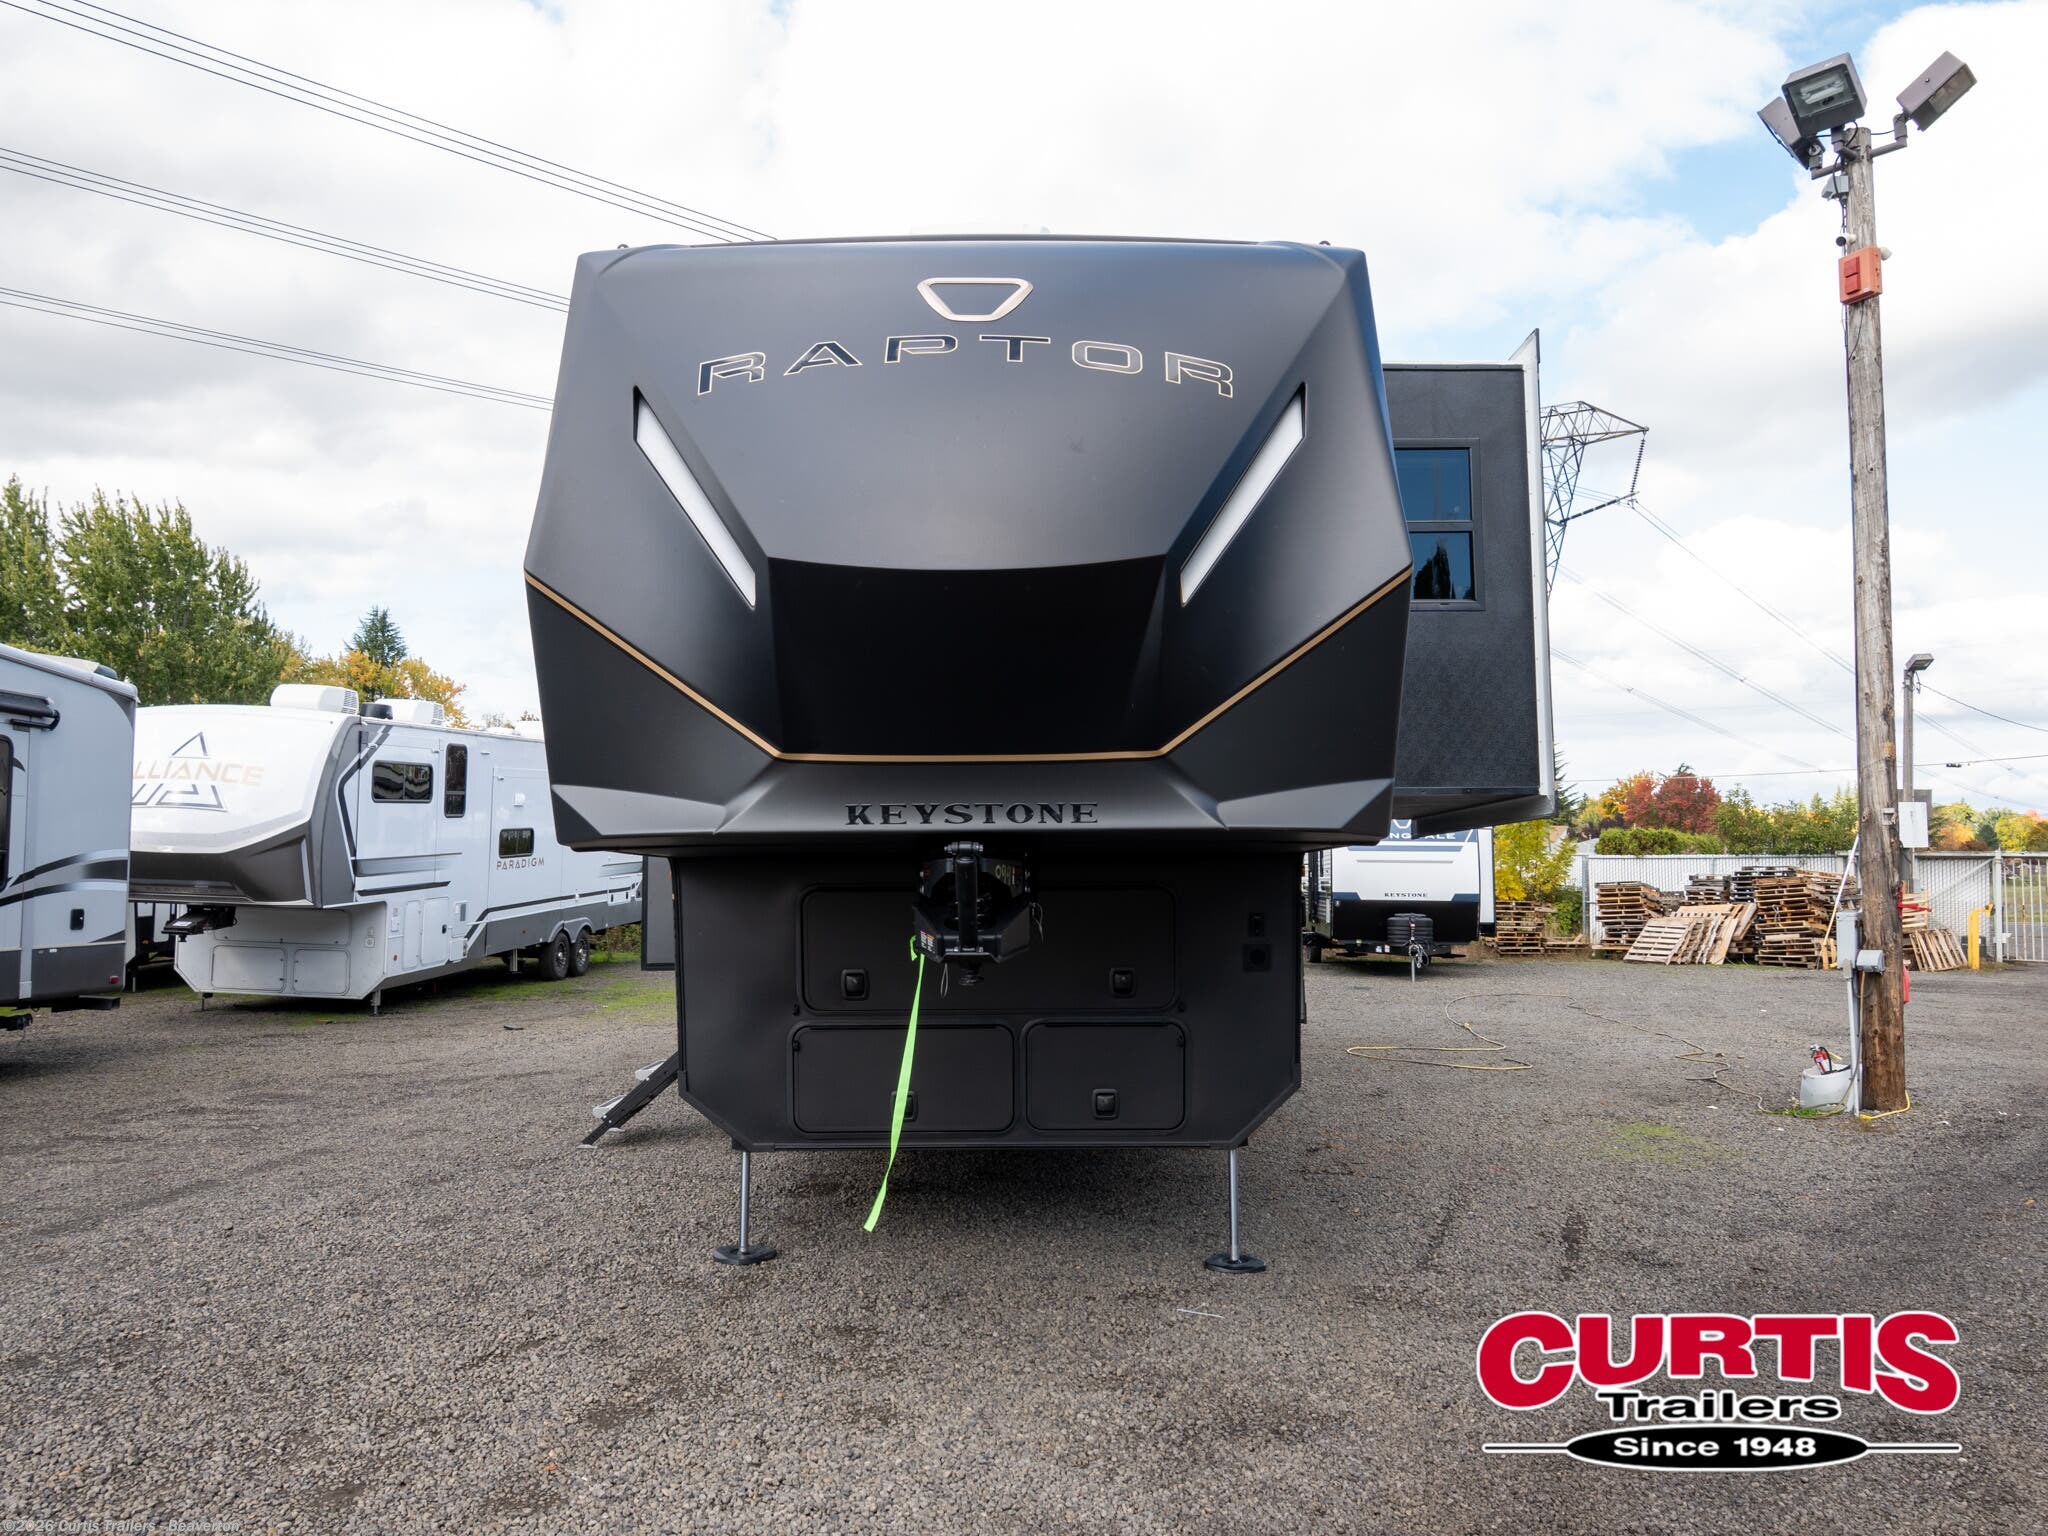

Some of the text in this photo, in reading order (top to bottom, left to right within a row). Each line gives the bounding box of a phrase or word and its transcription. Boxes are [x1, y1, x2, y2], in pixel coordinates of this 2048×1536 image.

[697, 334, 1234, 398] RAPTOR
[132, 760, 264, 785] LLIANCE
[845, 803, 1098, 825] KEYSTONE
[496, 857, 545, 871] PARADIGM
